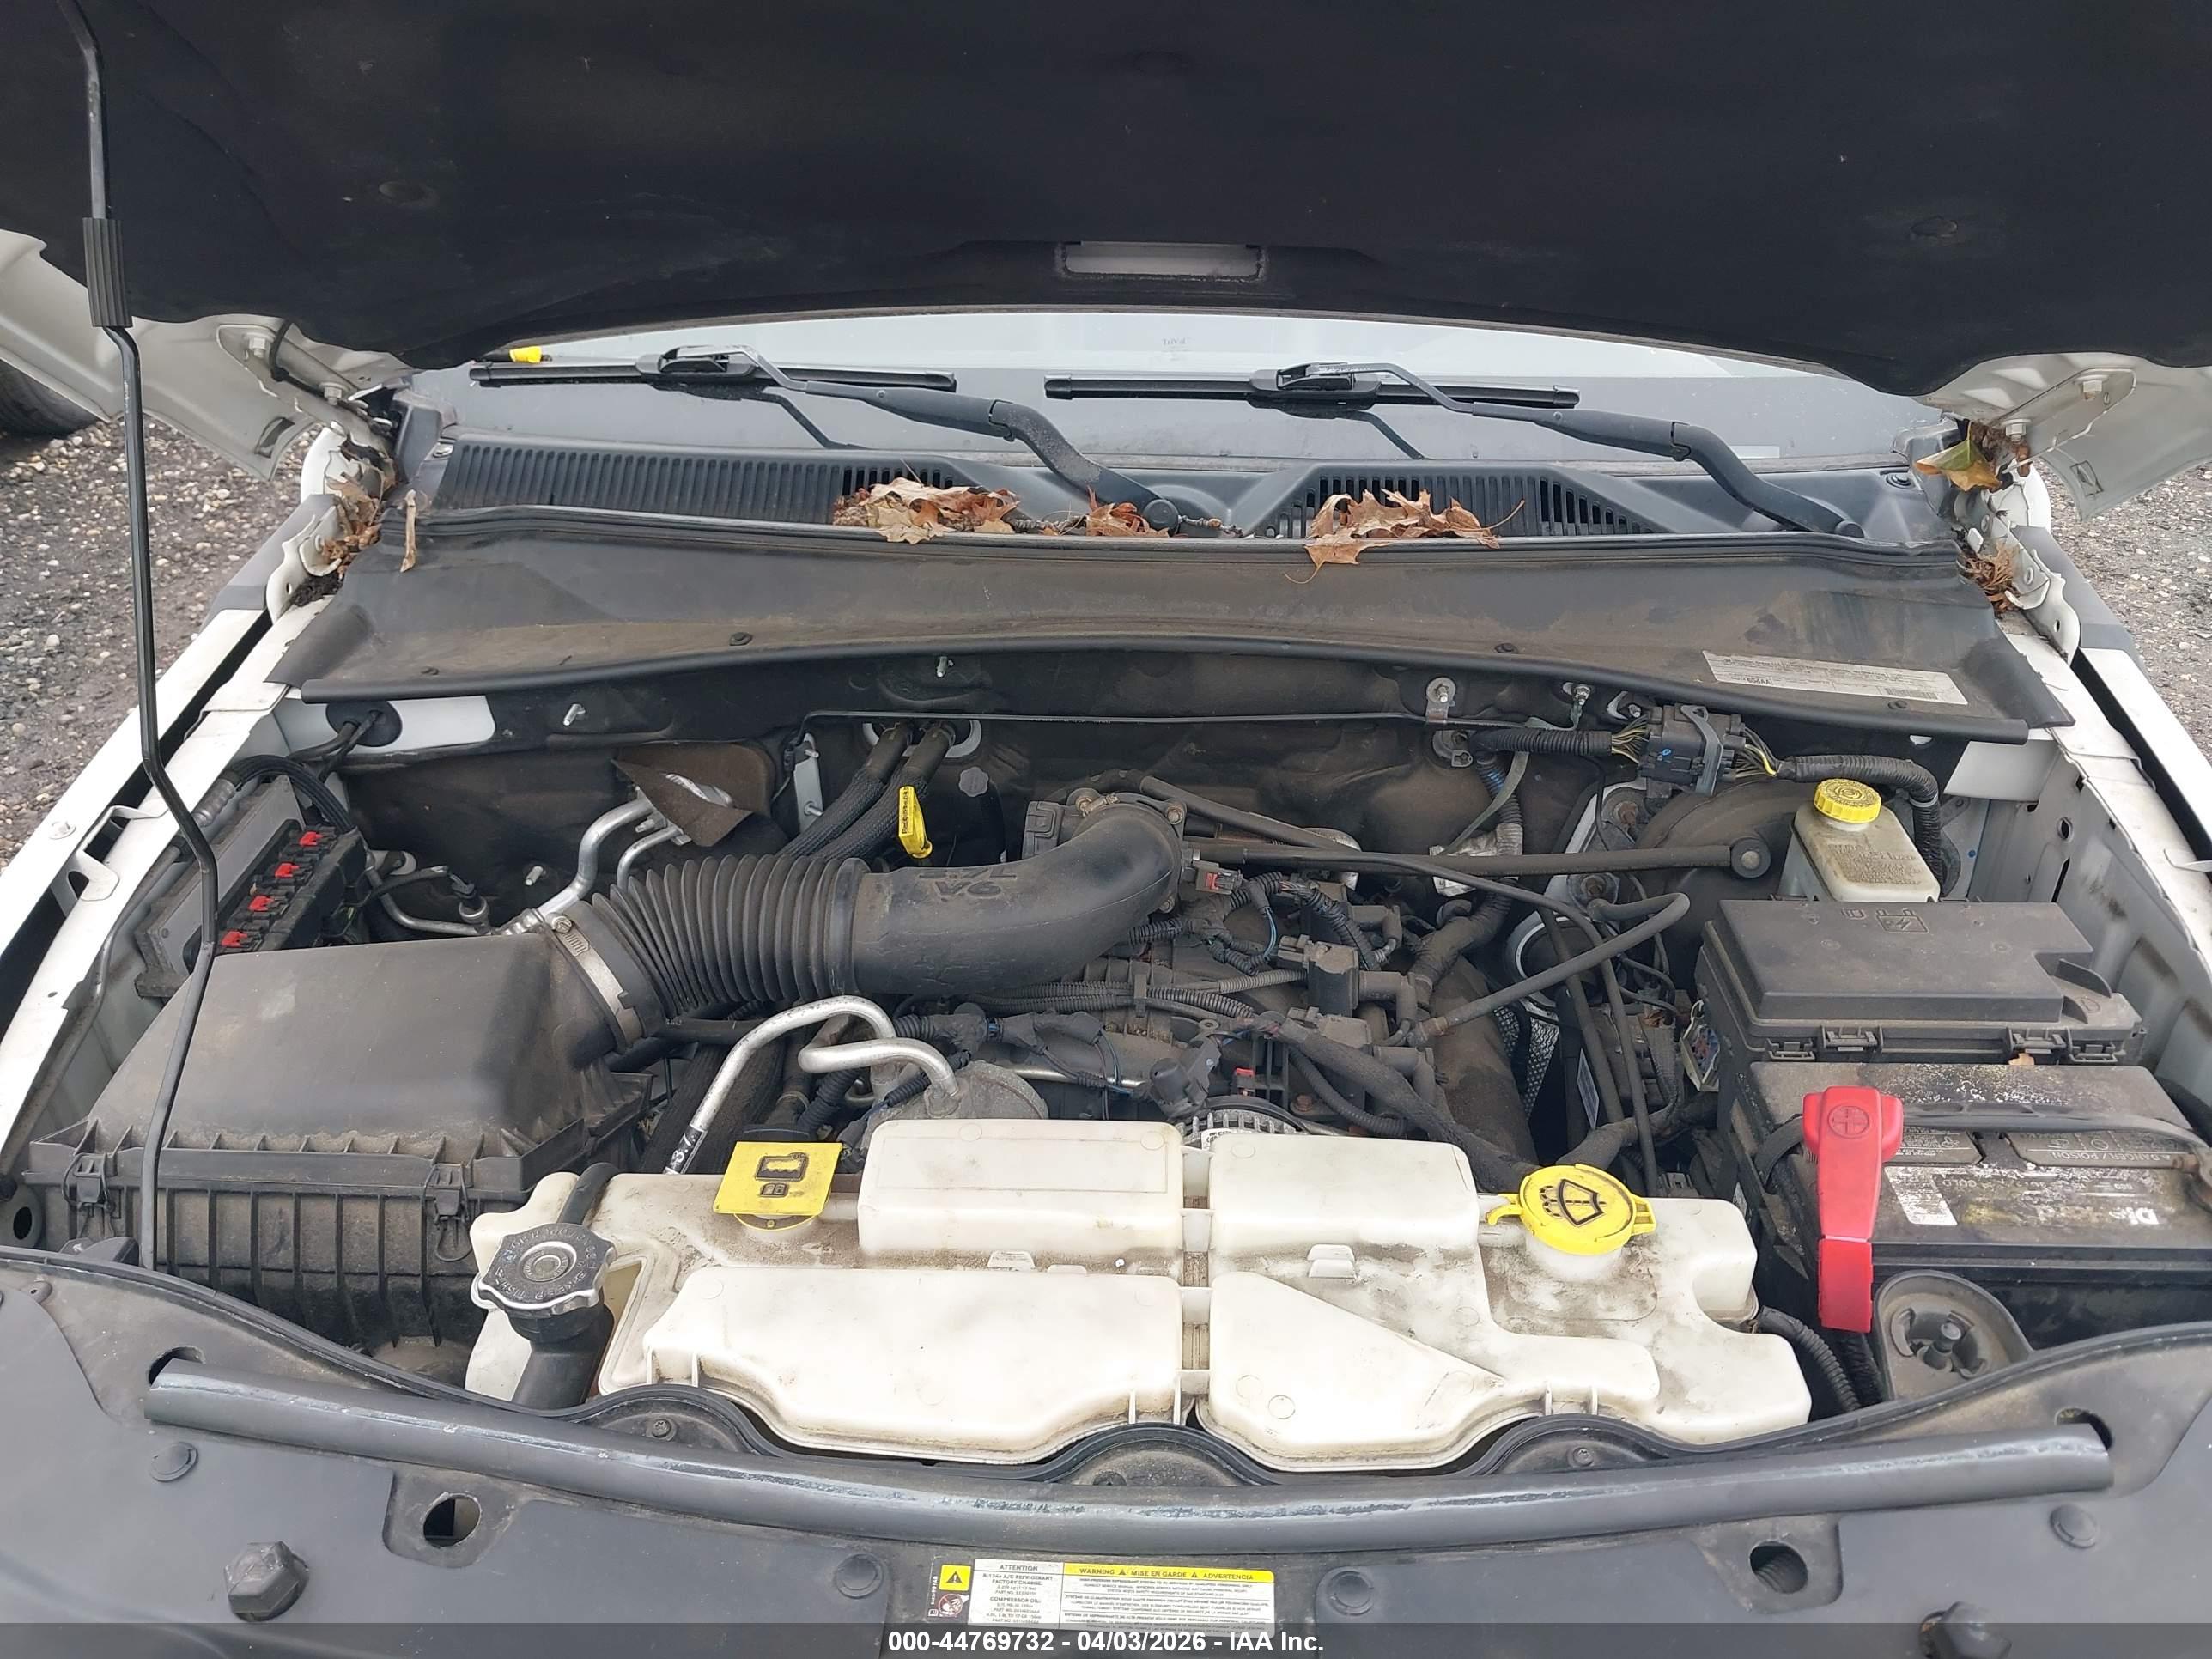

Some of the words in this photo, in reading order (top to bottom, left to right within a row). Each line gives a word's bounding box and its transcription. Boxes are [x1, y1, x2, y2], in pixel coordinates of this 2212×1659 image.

[933, 880, 1002, 897] V6
[2109, 1152, 2163, 1162] DANGER
[1203, 1572, 1254, 1581] ADVERTENCIA
